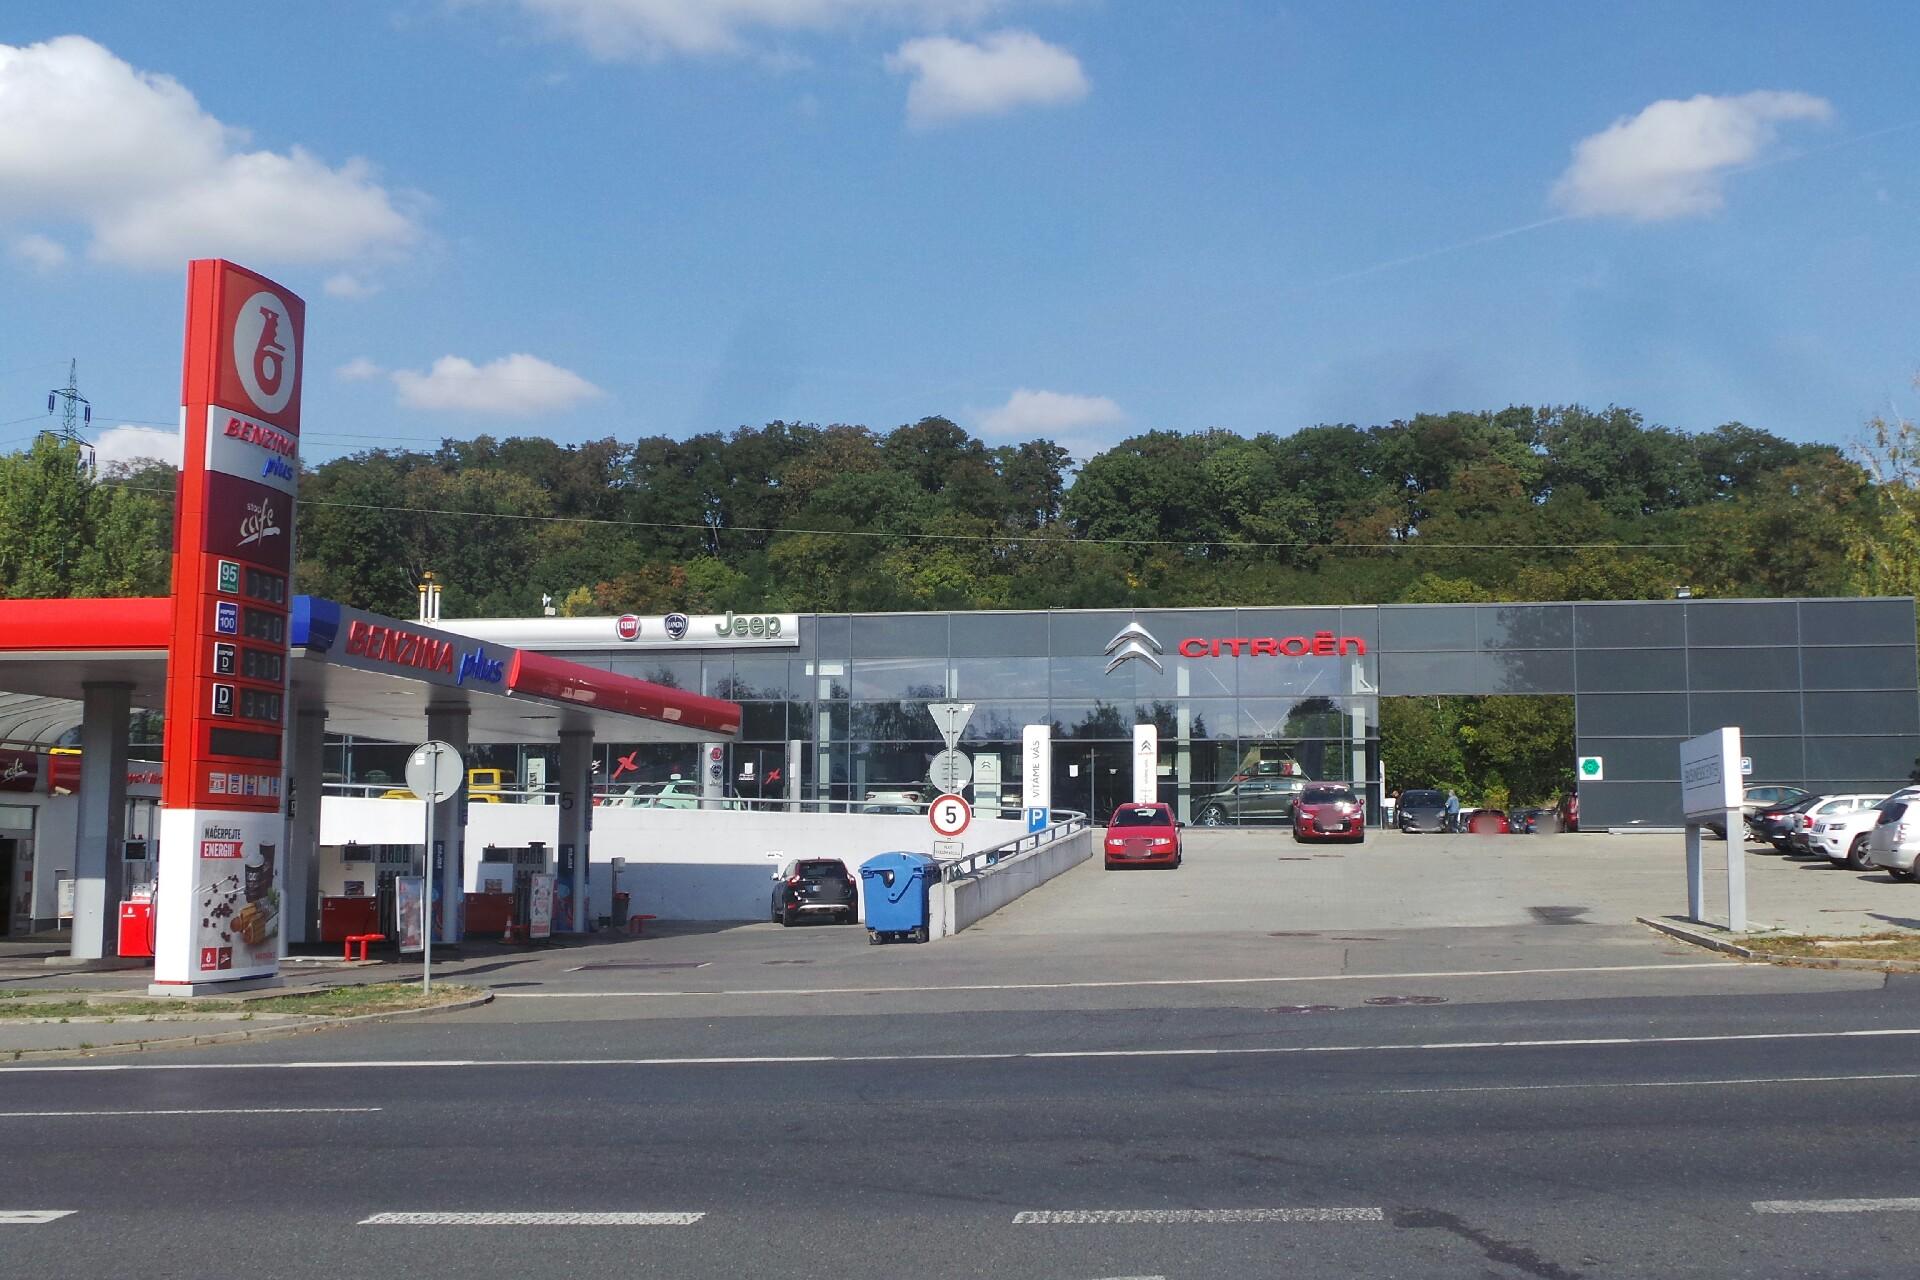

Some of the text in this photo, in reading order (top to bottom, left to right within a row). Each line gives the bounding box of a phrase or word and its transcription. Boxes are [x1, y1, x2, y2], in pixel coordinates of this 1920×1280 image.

[223, 416, 296, 459] BENZINA
[262, 456, 293, 480] plus
[222, 564, 237, 582] 95
[219, 617, 235, 629] 100
[715, 611, 781, 639] Jeep
[345, 620, 504, 685] BENZINA plus
[221, 656, 230, 668] D
[219, 687, 229, 704] D
[561, 791, 575, 810] 5
[944, 806, 957, 824] 5
[1032, 809, 1043, 826] P
